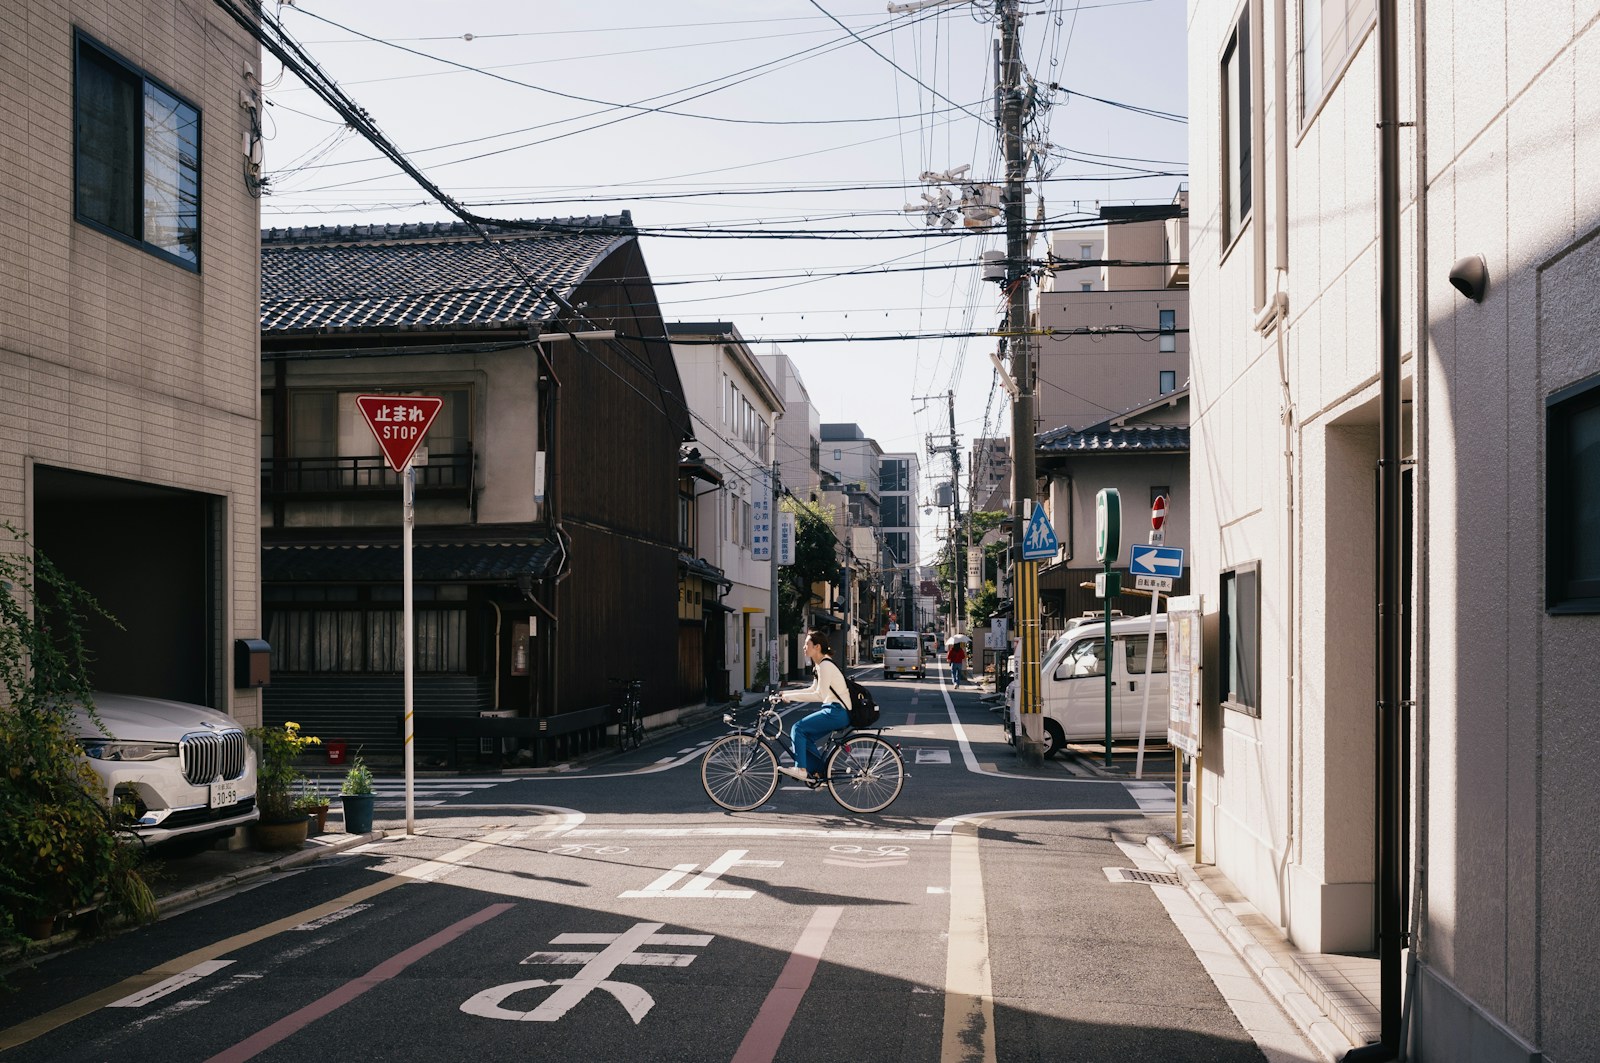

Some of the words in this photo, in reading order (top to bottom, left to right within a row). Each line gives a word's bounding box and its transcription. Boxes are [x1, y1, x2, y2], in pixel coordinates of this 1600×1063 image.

[374, 405, 425, 422] 止まれ
[383, 425, 417, 440] STOP
